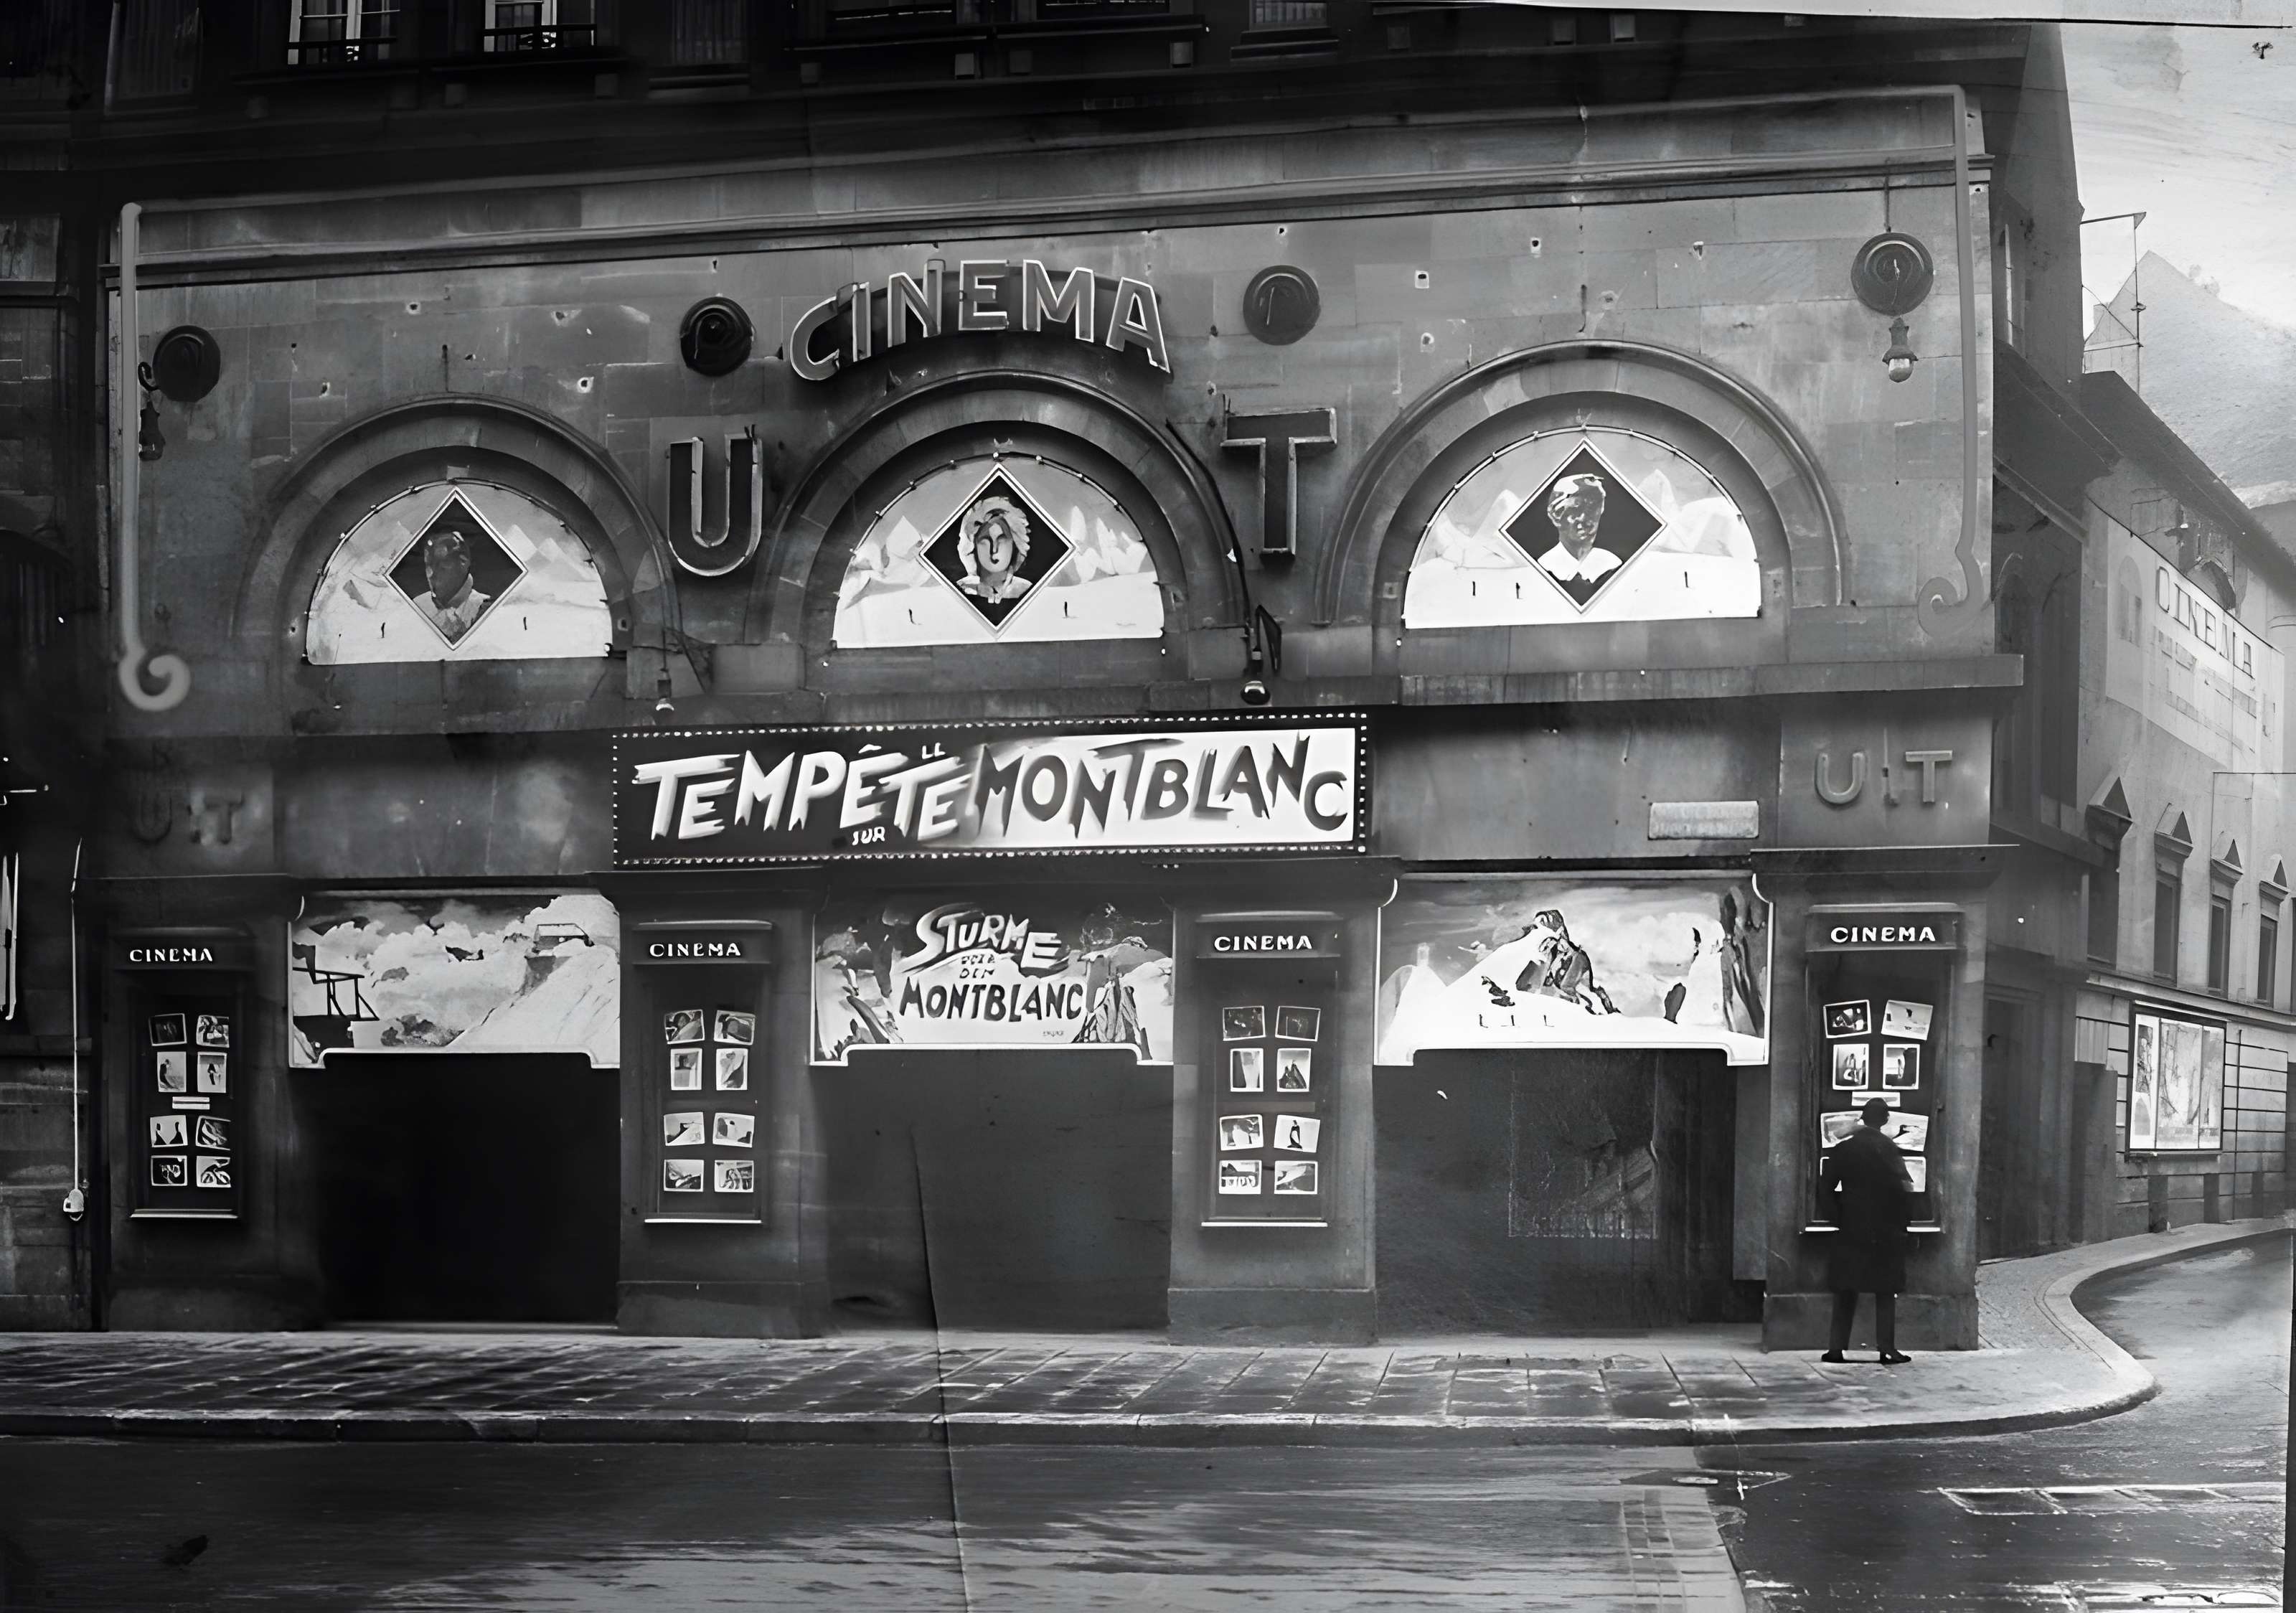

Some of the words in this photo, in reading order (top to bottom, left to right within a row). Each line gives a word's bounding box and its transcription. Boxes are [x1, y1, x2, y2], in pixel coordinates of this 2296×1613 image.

[790, 259, 1171, 381] CINEMA
[632, 743, 972, 841] TEMPÊTE
[1214, 935, 1312, 951] CINEMA
[1830, 926, 1936, 943] CINEMA
[129, 948, 213, 962] CINEMA
[649, 942, 741, 957] CINEMA
[899, 976, 1084, 1022] MONTBLANC
